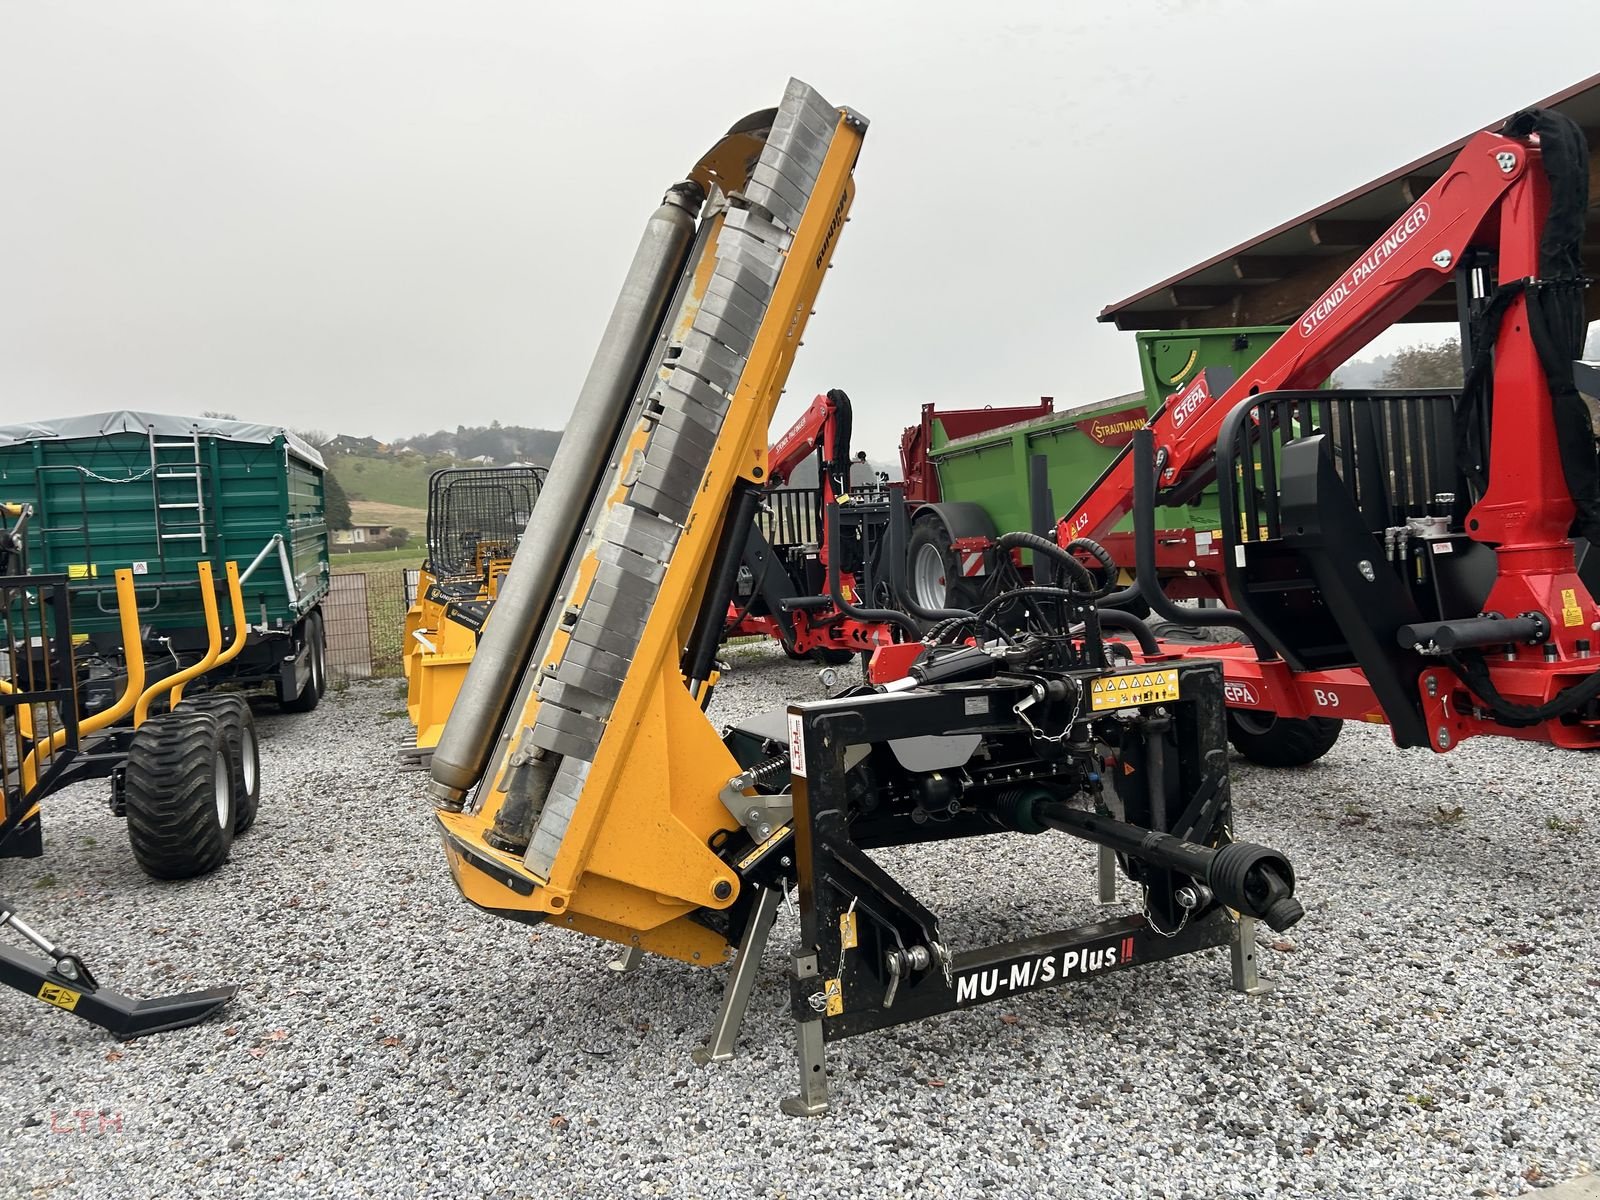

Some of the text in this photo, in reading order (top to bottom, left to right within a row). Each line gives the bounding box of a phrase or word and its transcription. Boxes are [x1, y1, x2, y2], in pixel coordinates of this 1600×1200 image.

[1302, 207, 1426, 335] STEINDL-PALFINGER
[1173, 388, 1206, 427] STEPA
[1224, 687, 1255, 703] EPA
[1314, 689, 1340, 707] B9
[956, 956, 1055, 1003] MU-M/S
[1062, 946, 1117, 978] Plus
